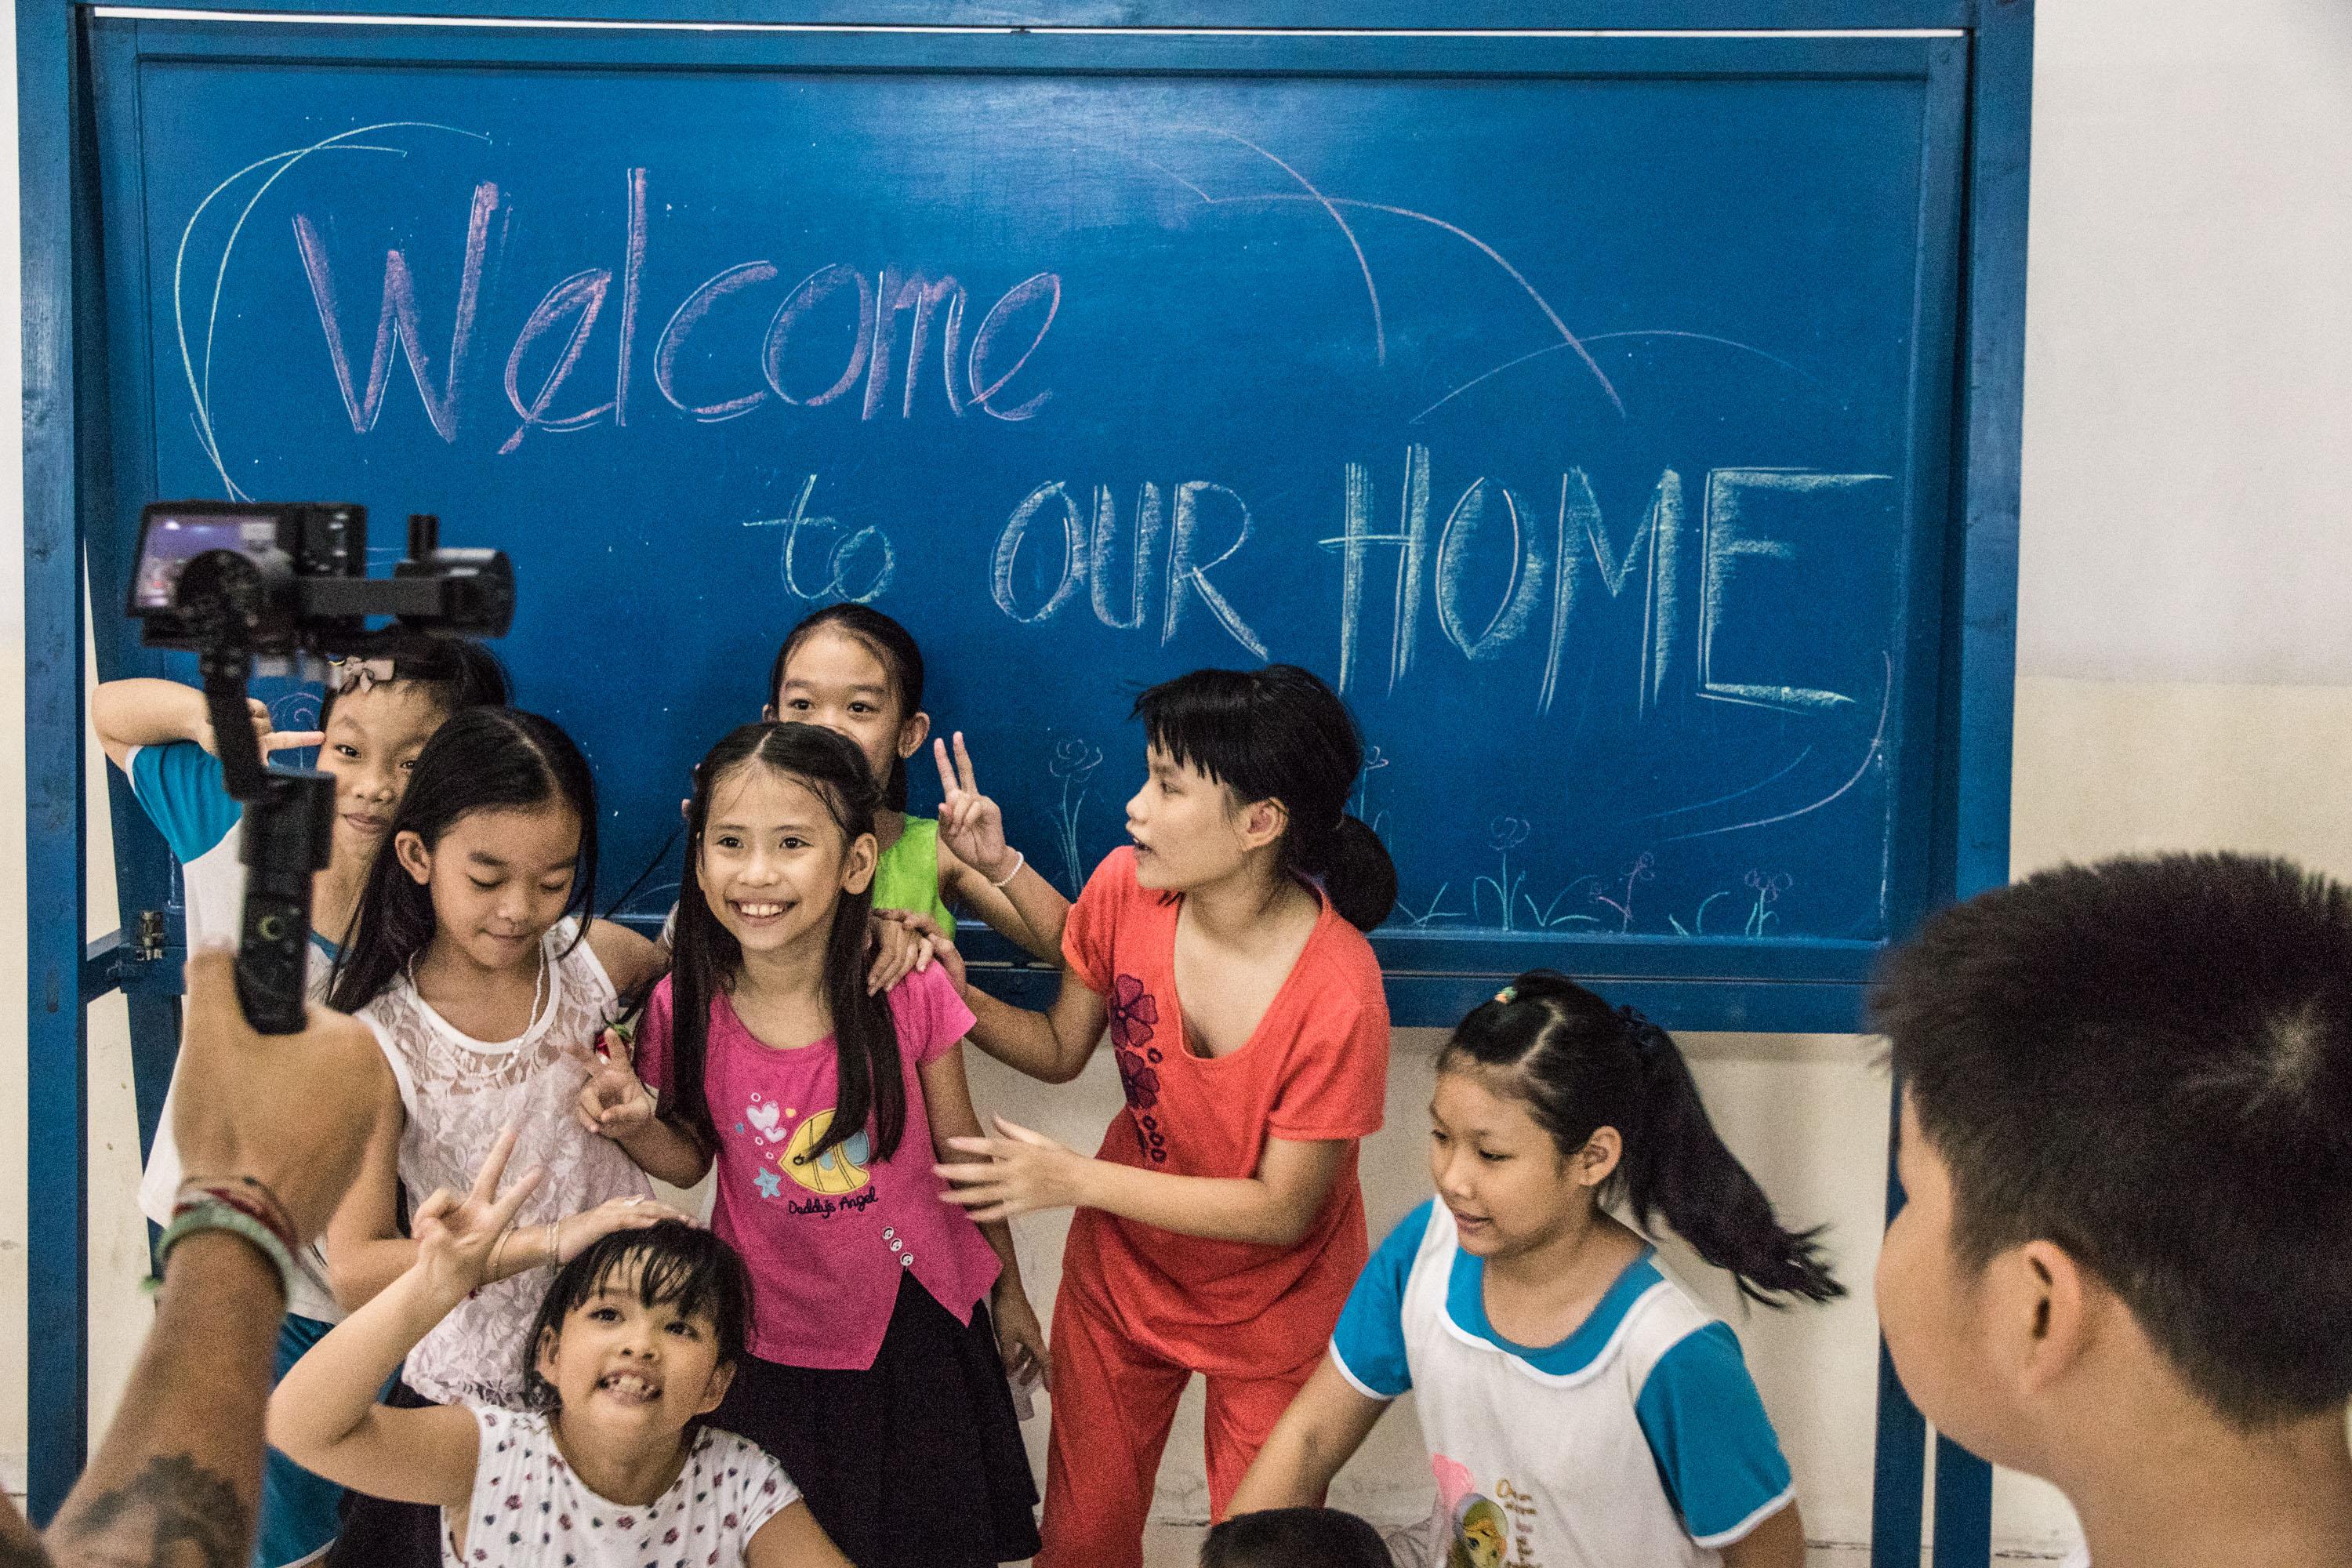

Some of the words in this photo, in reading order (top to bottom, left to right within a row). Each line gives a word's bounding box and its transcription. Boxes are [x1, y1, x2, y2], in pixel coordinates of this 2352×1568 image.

[291, 166, 1062, 455] Welcome
[742, 473, 895, 603] to
[989, 480, 1269, 662] OUR
[1317, 442, 1893, 721] HOME
[788, 1197, 837, 1219] Daddy's
[839, 1185, 879, 1212] Angel
